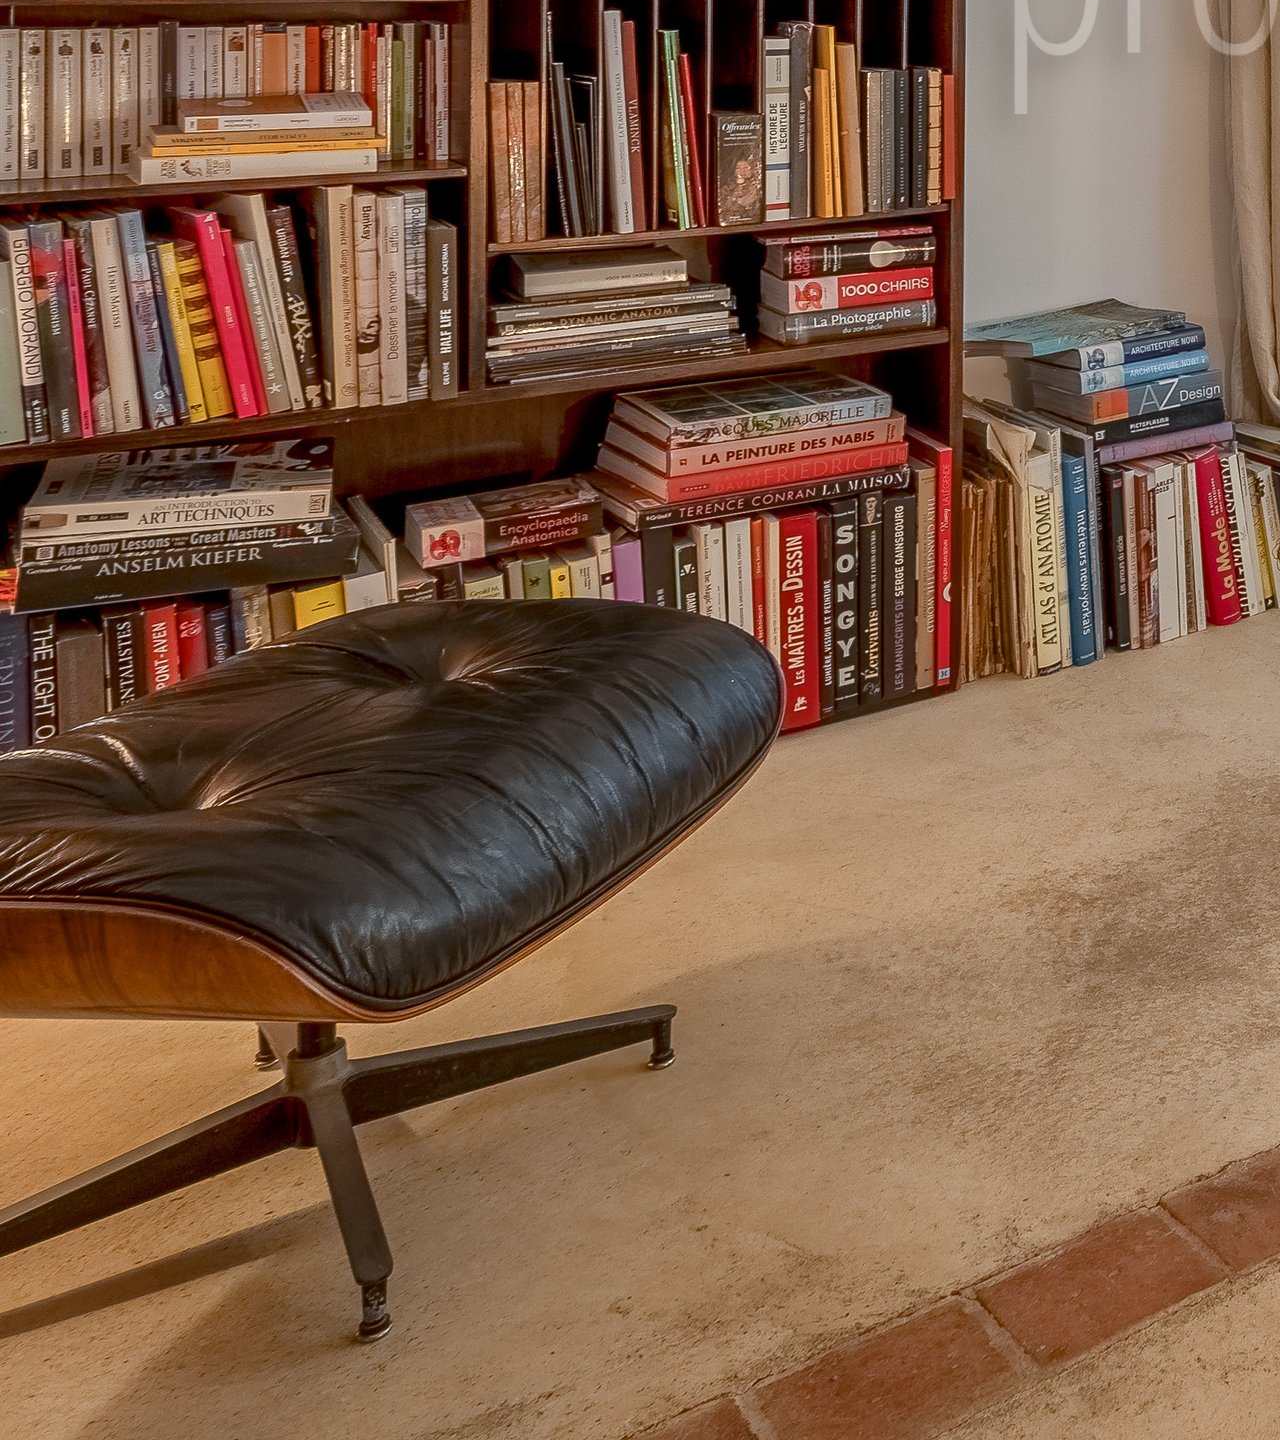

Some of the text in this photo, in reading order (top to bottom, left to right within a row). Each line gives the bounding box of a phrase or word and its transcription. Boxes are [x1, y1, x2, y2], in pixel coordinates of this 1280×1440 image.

[628, 99, 642, 154] VLAMINCK
[721, 122, 761, 133] Offrandes
[769, 102, 778, 155] HISTOIRE DE
[361, 205, 372, 240] Banksy
[841, 277, 930, 298] 1000 CHAIRS
[13, 237, 41, 381] GIORGIO MORANDI
[387, 270, 399, 361] Dessiner monde
[560, 306, 680, 326] DYNAMIC ANATOMY
[813, 306, 912, 329] La Photographie
[440, 308, 452, 354] HALF LIFE
[1130, 334, 1199, 356] ARCHITECTURE NOW!
[1129, 359, 1181, 378] ARCHITECTURE
[1179, 384, 1221, 403] Design
[707, 405, 865, 438] JACQUES MAJORELLE
[1129, 416, 1170, 430] PICTOPLASMA
[701, 430, 875, 466] LA PEINTURE DES NABIS
[764, 450, 886, 483] FRIEDRICH
[1155, 477, 1175, 489] ARLES
[166, 499, 248, 511] INTRODUCTION
[679, 473, 904, 518] TERENCE CONRAN LA MAISON
[137, 504, 275, 526] ART TECHNIQUES
[500, 511, 589, 536] Encyclopaedia
[57, 525, 276, 558] Anatomy Lessons Great Masters
[510, 526, 579, 548] Anatomica
[96, 546, 263, 577] ANSELM KIEFER
[1076, 509, 1092, 636] Intérieurs new-yorkais
[1210, 516, 1235, 601] La Mode
[781, 535, 805, 667] MAÎTRES DESSIN
[823, 579, 832, 617] PEINTURE
[836, 524, 856, 688] SONGYE
[894, 505, 905, 691] LES MANUSCRITS DE SERGE GAINSBOURG
[1039, 599, 1058, 647] ATLAS
[32, 624, 56, 717] THE LIGHT
[151, 621, 171, 691] PONT-AVEN
